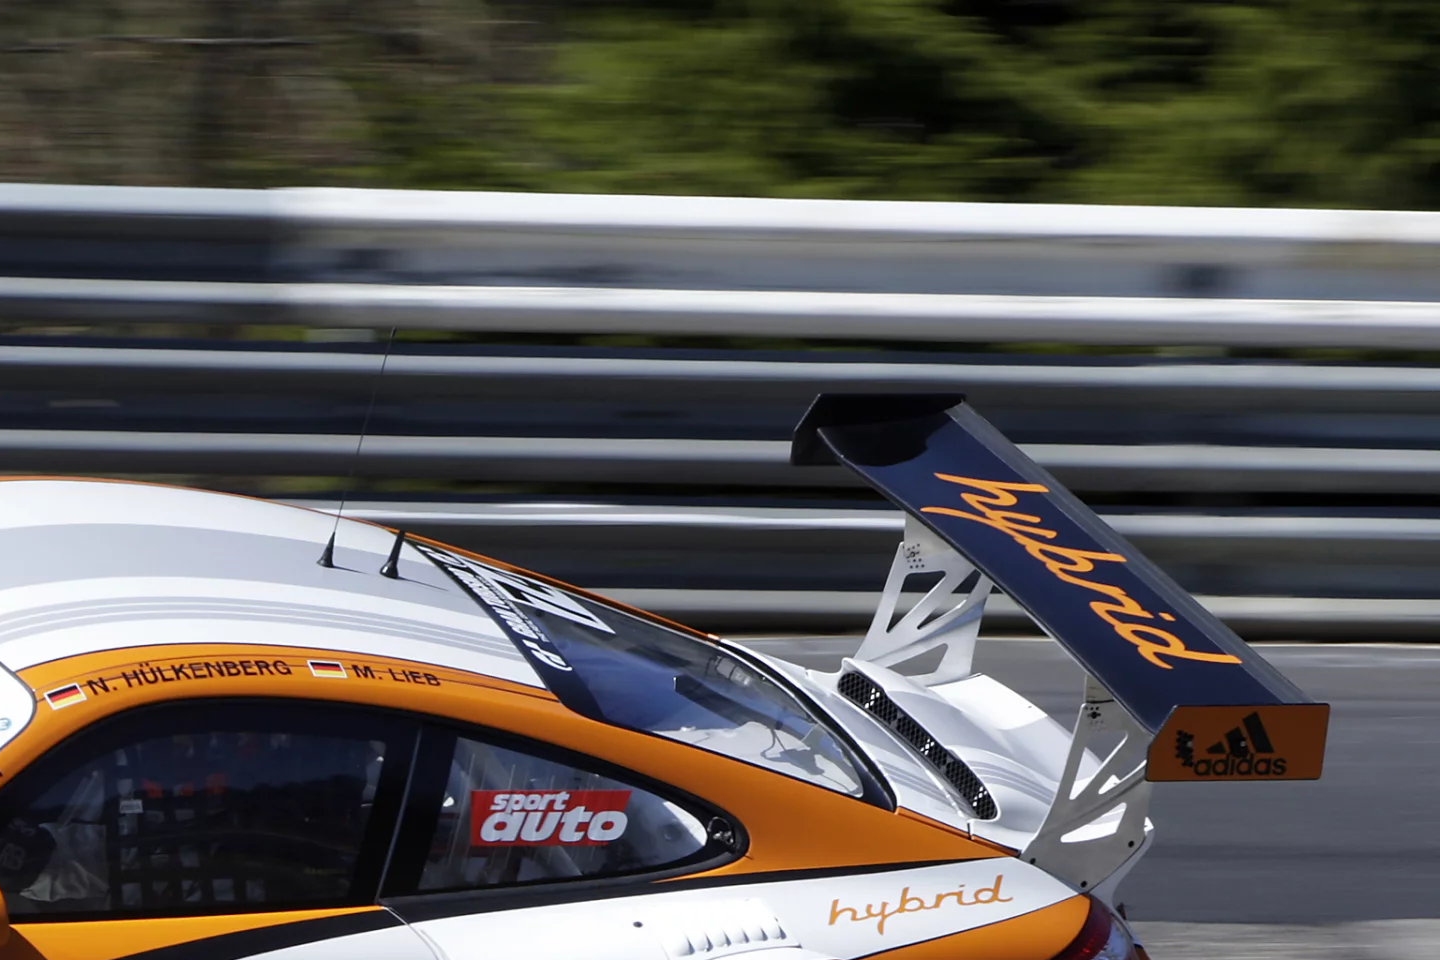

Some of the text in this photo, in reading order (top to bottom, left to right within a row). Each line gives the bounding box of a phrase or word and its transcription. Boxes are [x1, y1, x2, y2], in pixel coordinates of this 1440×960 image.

[920, 473, 1243, 670] hybrid
[87, 661, 292, 696] N. HÜLKENBERG
[351, 664, 442, 687] M. LIEB
[1193, 753, 1288, 776] adidas
[490, 791, 570, 813] sport
[480, 806, 628, 842] auto
[828, 874, 1014, 935] hybrid
